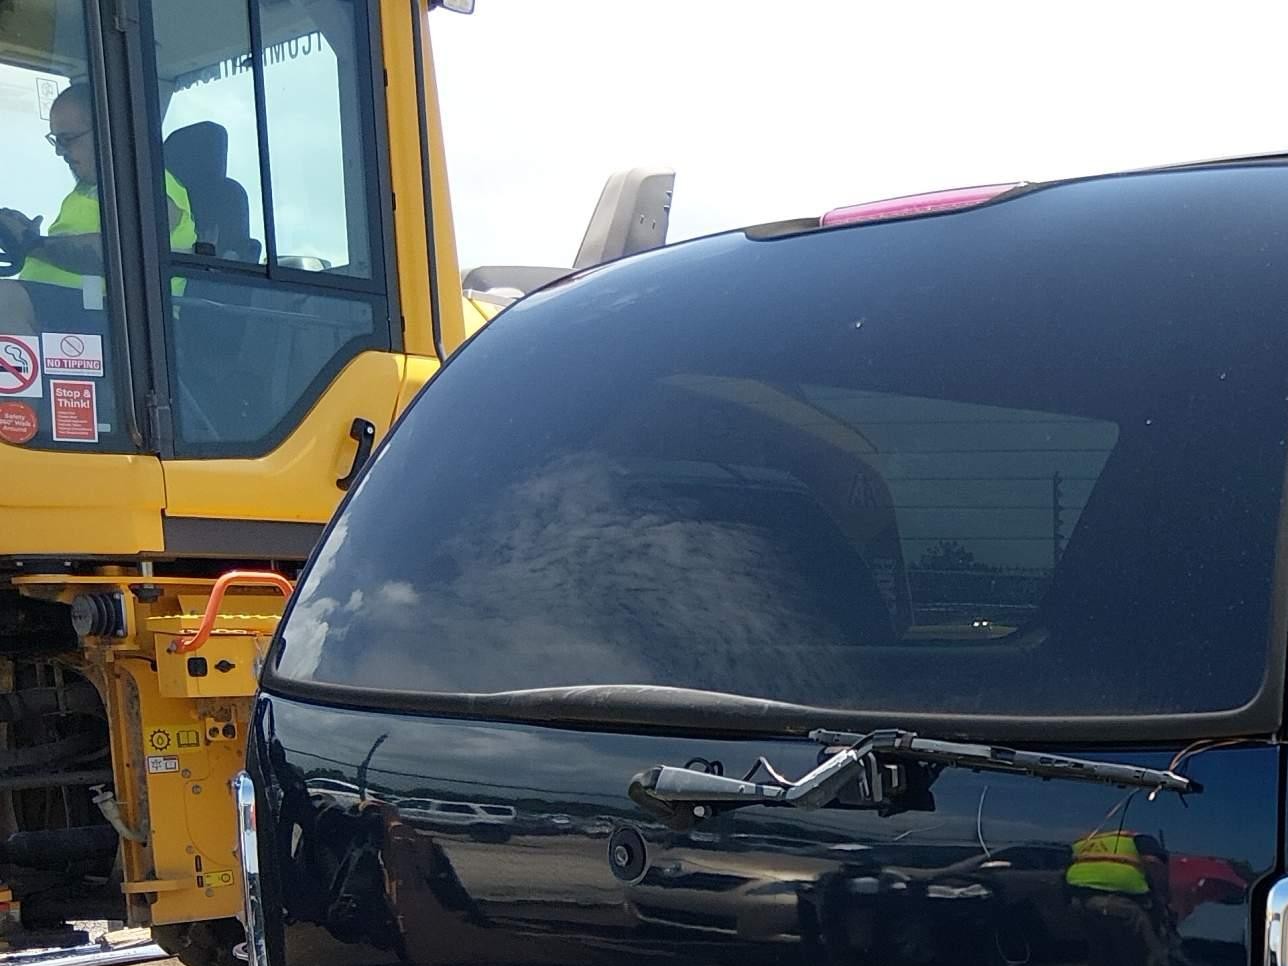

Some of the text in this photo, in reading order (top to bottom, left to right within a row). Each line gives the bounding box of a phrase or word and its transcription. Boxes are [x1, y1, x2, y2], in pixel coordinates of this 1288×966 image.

[47, 359, 100, 369] NO TIPPING
[55, 388, 91, 399] Stop &
[57, 398, 90, 409] Think!
